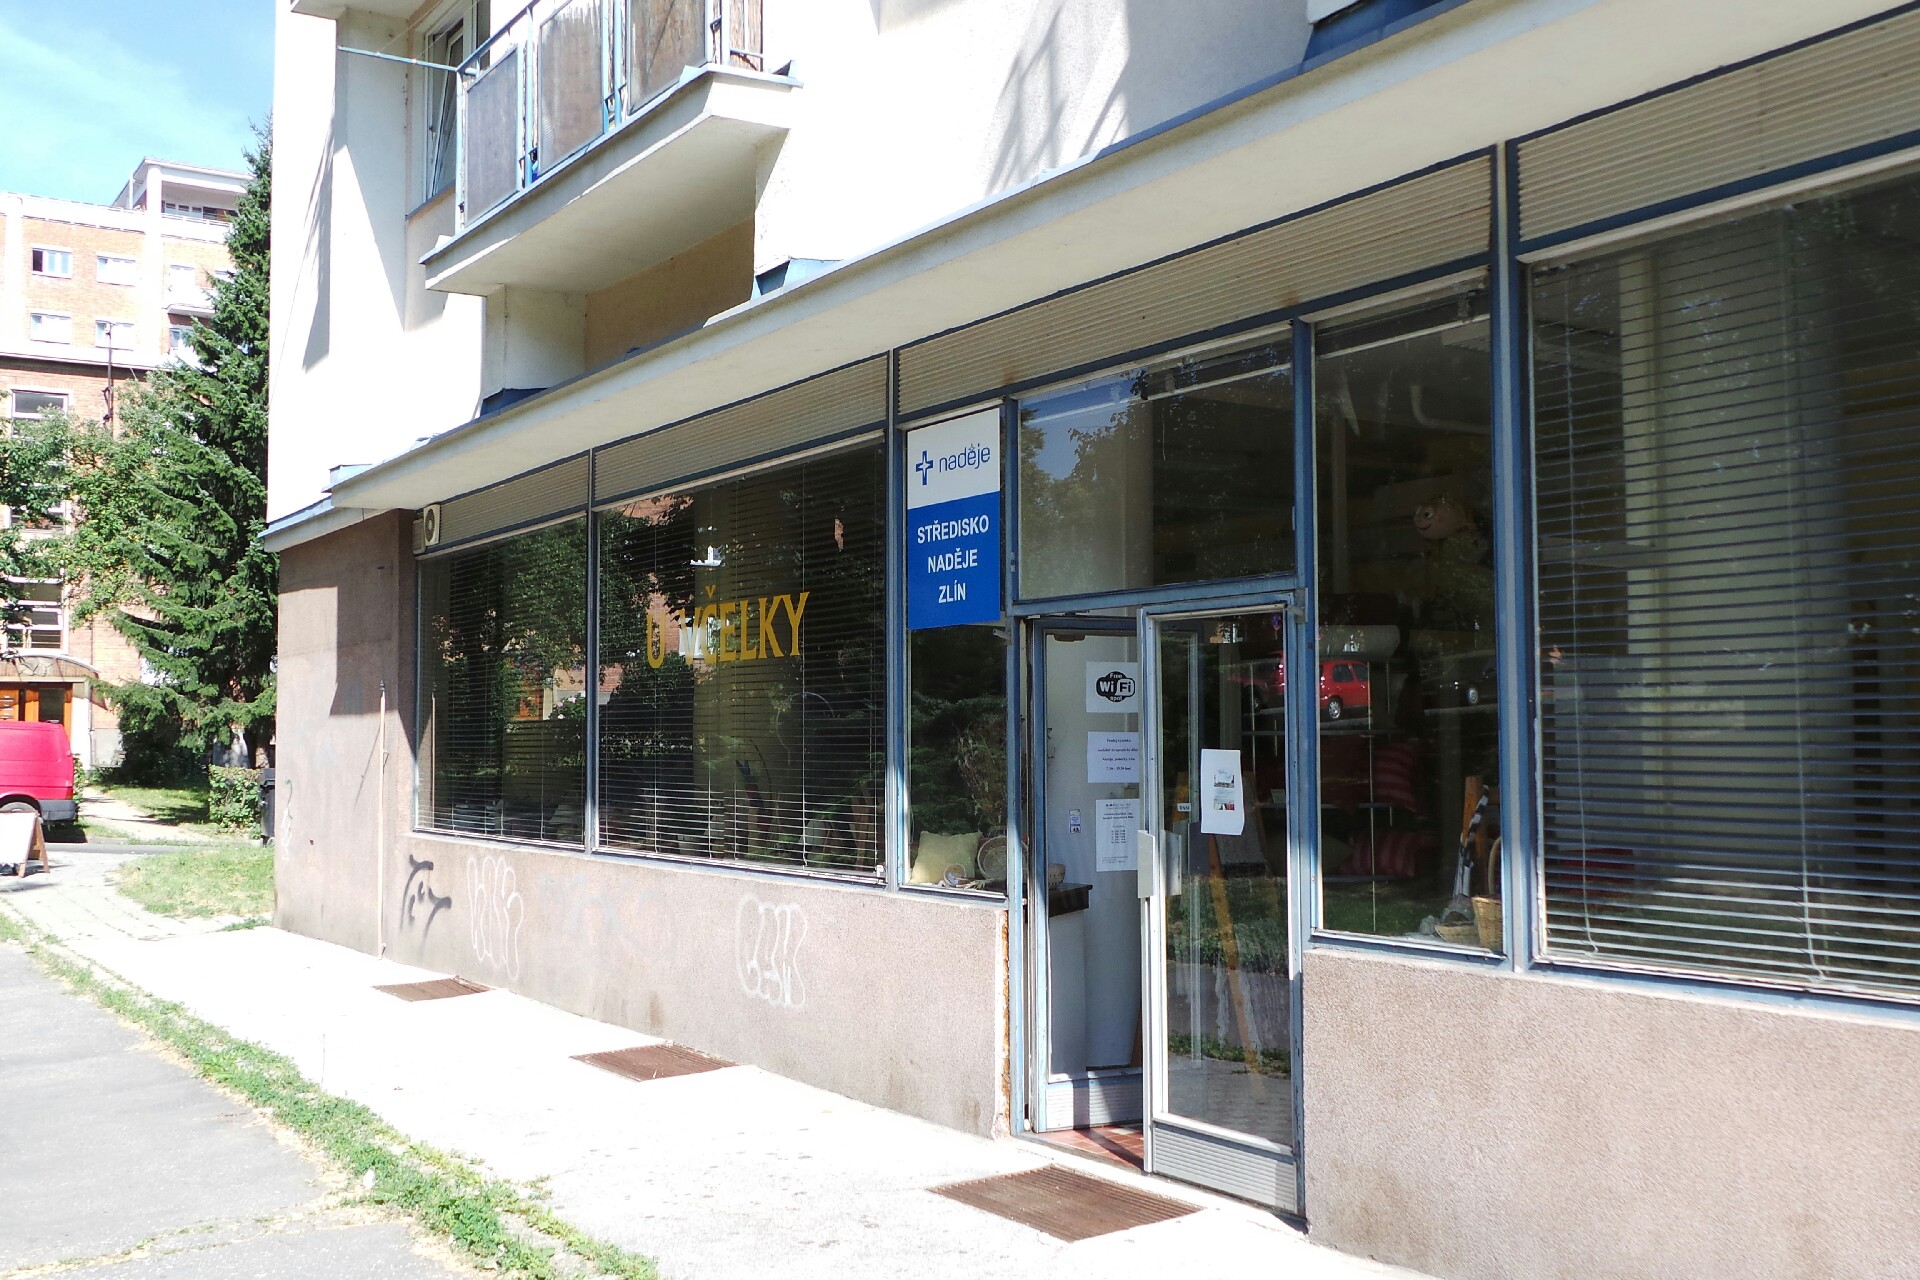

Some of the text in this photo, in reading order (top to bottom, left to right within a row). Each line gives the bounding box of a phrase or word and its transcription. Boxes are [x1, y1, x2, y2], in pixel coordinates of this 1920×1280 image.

[939, 443, 990, 473] naděje
[917, 514, 989, 544] STŘEDISKO
[928, 548, 978, 573] NADĚJE
[938, 579, 966, 603] ZLÍN
[646, 585, 810, 668] U VČELKY
